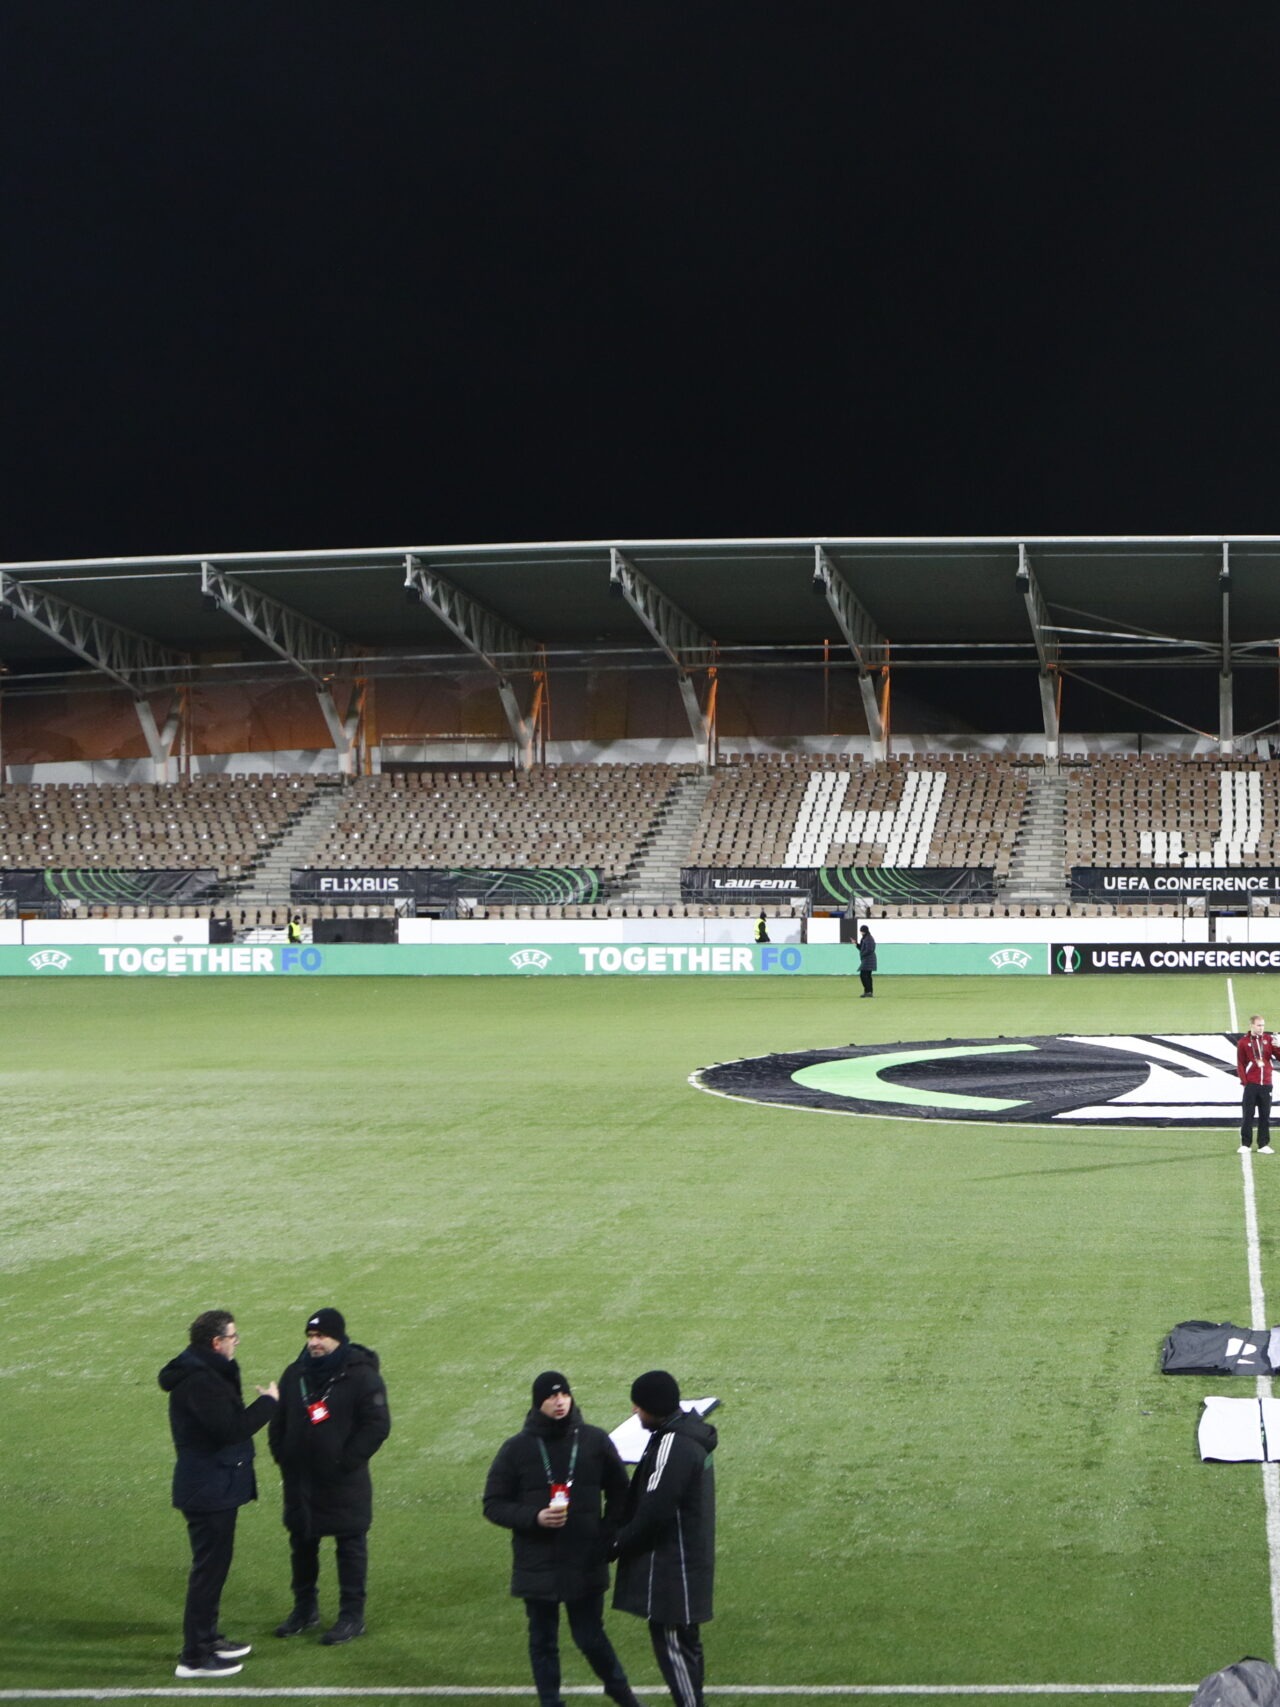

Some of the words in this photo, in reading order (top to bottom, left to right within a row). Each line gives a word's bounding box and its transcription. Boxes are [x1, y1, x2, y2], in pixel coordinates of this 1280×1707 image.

[1103, 876, 1149, 891] UEFA
[1154, 876, 1269, 892] CONFERENCE
[29, 951, 70, 970] UEFA
[98, 947, 274, 972] TOGETHER
[281, 947, 322, 972] FO
[510, 950, 551, 969] UEFA
[578, 946, 754, 971] TOGETHER
[761, 947, 802, 971] FO
[990, 950, 1031, 969] UEFA
[1092, 950, 1146, 967] UEFA
[1150, 950, 1280, 967] CONFERENCE
